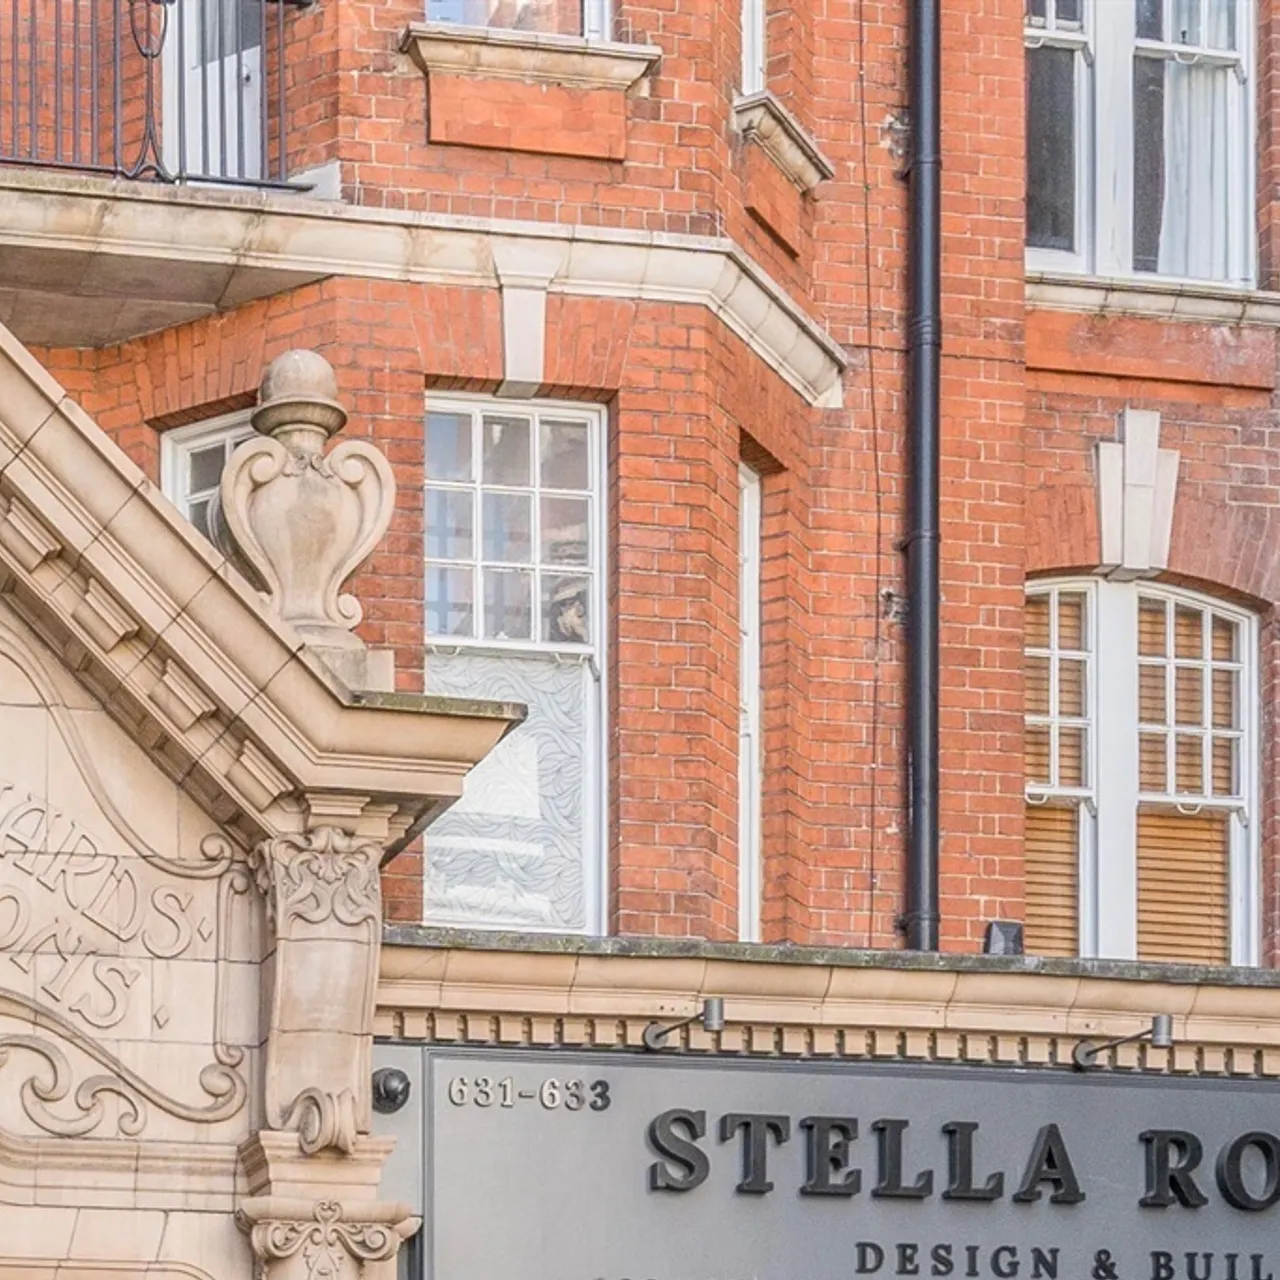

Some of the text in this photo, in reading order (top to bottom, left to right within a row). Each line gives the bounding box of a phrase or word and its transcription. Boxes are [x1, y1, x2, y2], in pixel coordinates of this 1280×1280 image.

[448, 1075, 612, 1112] 631-633
[646, 1108, 1086, 1205] STELLA
[854, 1241, 1060, 1280] DESIGN
